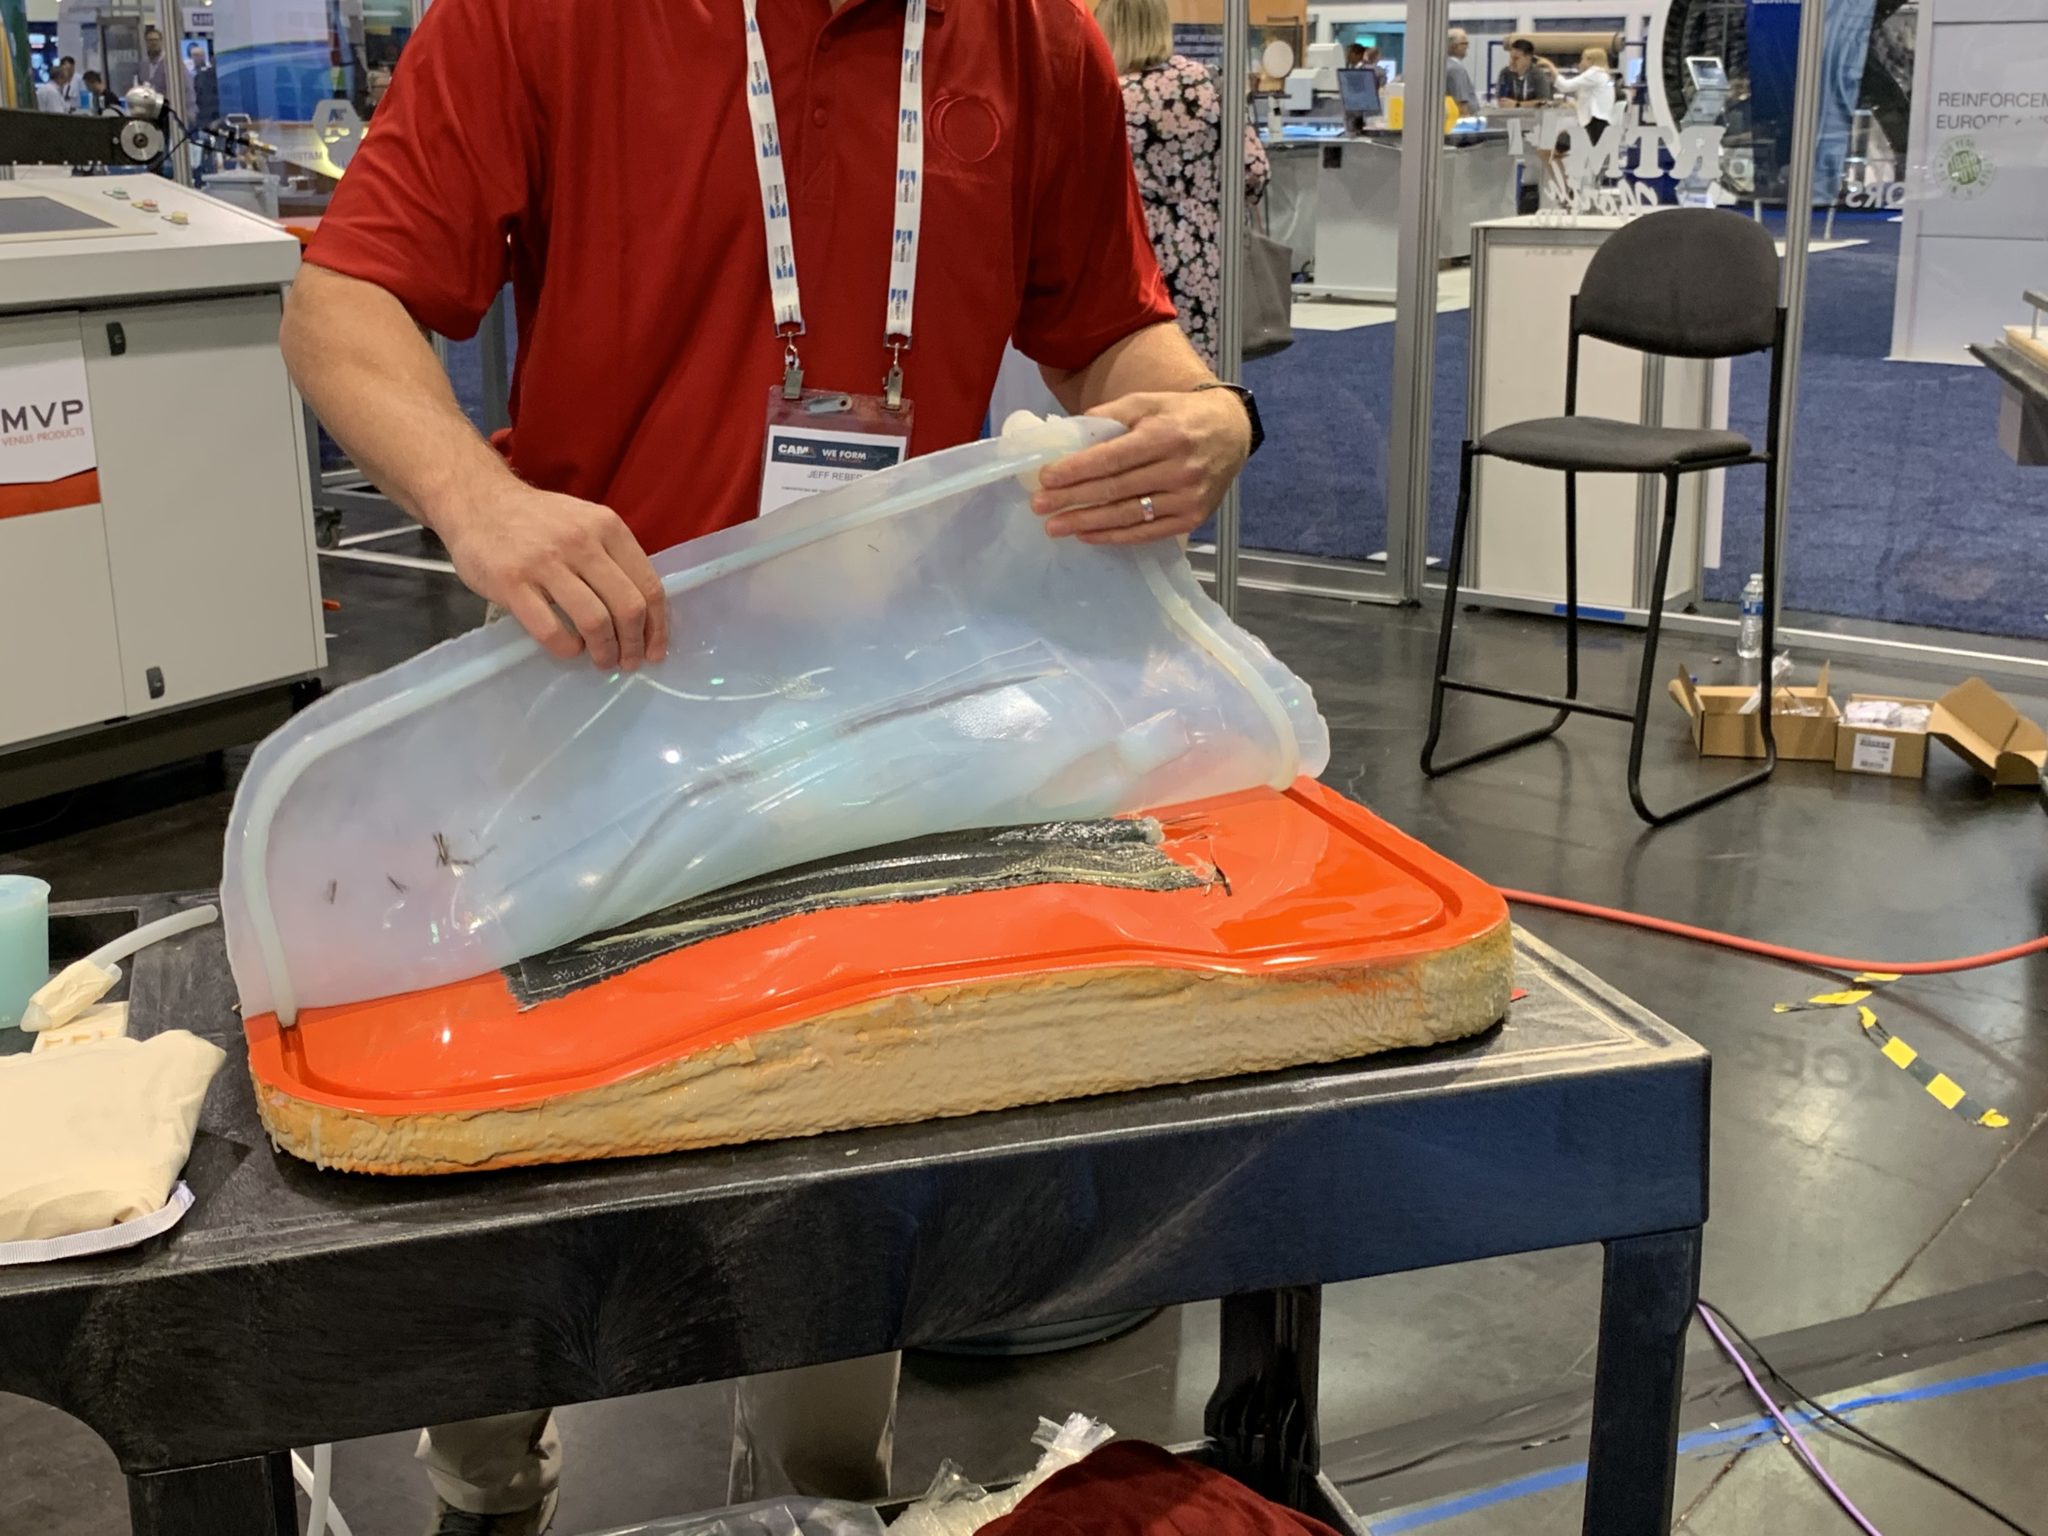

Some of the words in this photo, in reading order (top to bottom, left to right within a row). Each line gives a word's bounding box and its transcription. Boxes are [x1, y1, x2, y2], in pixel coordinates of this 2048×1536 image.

[1, 399, 84, 433] MVP
[1, 434, 34, 446] VENUS
[37, 427, 85, 441] PRODUCTS
[839, 450, 867, 460] FORM
[807, 470, 830, 479] JEFF
